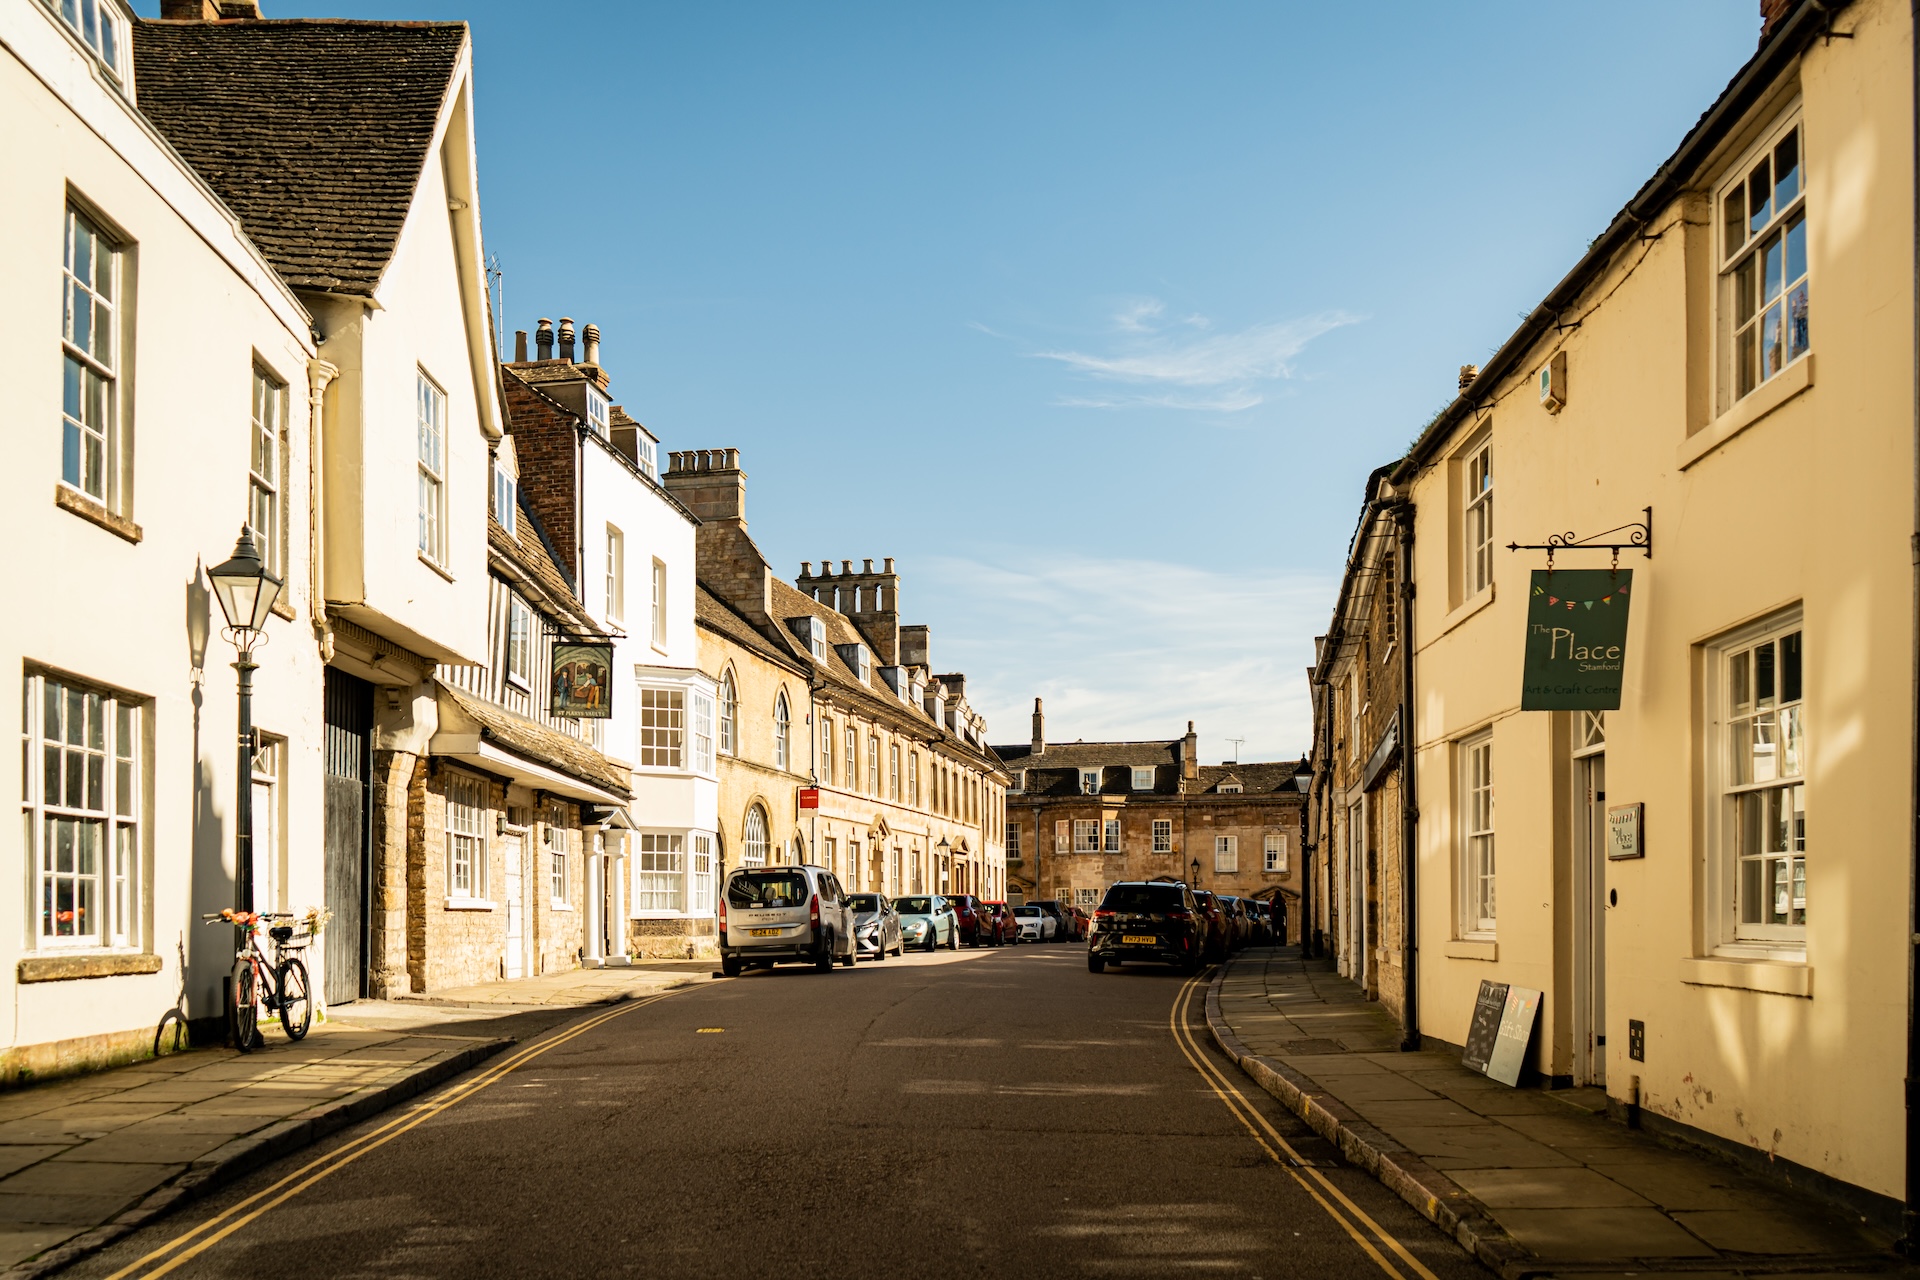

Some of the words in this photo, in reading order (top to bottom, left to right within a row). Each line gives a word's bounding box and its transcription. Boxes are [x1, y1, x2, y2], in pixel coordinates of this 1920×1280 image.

[1531, 624, 1551, 635] The
[1550, 627, 1621, 660] Place
[1578, 661, 1621, 673] Stamford
[1525, 685, 1543, 695] Art
[1543, 685, 1552, 695] &
[1554, 683, 1580, 695] Craft
[1584, 685, 1619, 695] Centre
